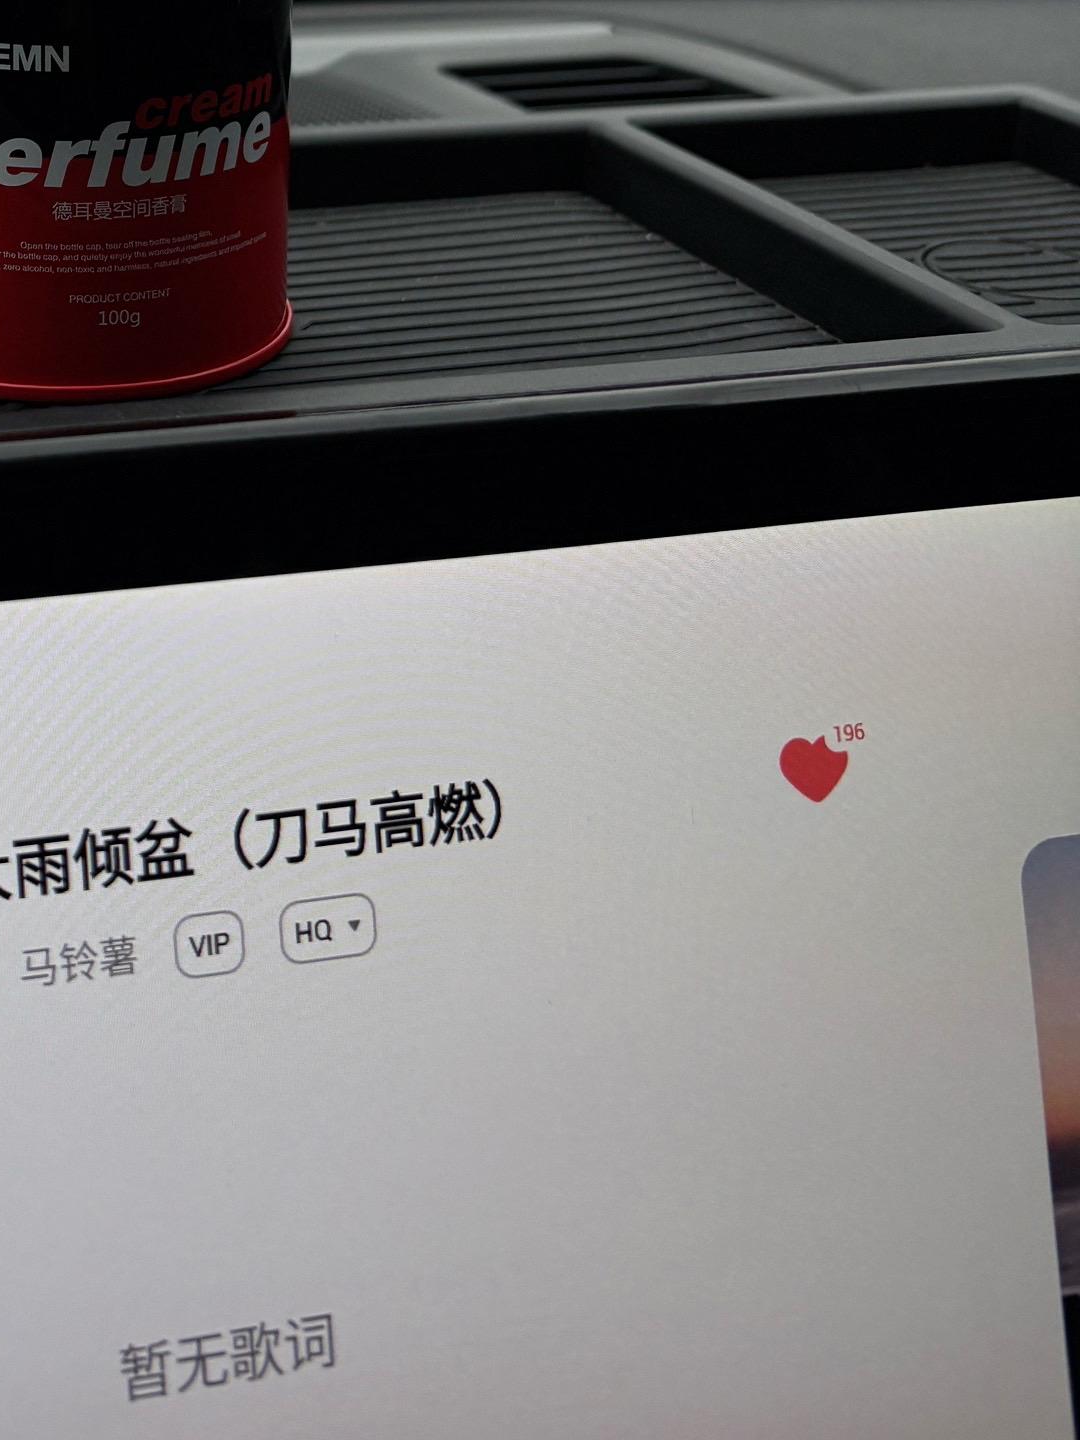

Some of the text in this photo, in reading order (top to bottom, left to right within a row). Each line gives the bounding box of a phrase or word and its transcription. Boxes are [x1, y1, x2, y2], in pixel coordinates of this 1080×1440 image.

[135, 72, 273, 129] cream
[52, 194, 187, 222] 德耳曼空间香膏
[3, 250, 16, 259] the
[17, 251, 41, 260] bottle
[42, 254, 61, 262] cap,
[133, 250, 147, 258] the
[19, 241, 43, 251] Open
[44, 242, 58, 250] the
[60, 243, 84, 251] bottle
[123, 240, 134, 249] off
[3, 263, 21, 271] zero
[22, 264, 55, 274] alcohol,
[96, 265, 113, 273] and
[68, 288, 171, 304] PRODUCT CONTENT
[98, 309, 141, 327] 100g
[833, 722, 866, 743] 196
[294, 917, 334, 945] HQ
[188, 932, 231, 959] VIP
[21, 936, 138, 987] 马铃薯
[120, 1313, 336, 1402] 暂无歌词
